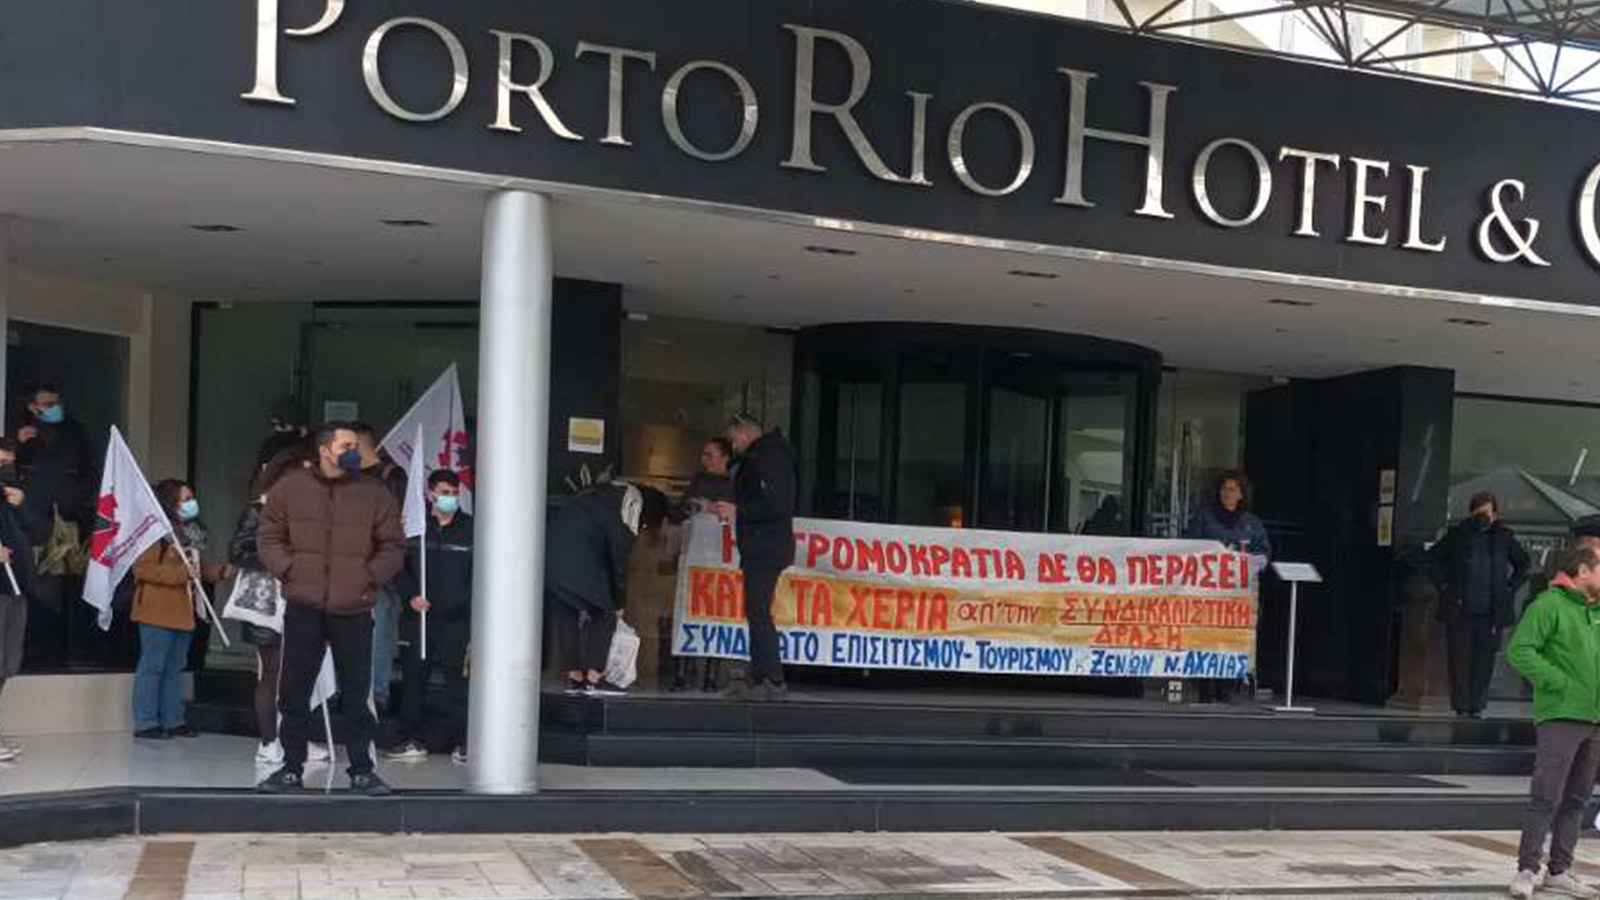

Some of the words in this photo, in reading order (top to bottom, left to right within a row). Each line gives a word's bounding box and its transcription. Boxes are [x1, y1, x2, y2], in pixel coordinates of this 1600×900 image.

[1477, 179, 1551, 267] &
[1037, 552, 1071, 583] ΔΕ
[1077, 554, 1117, 585] ΘΑ
[1126, 553, 1249, 590] ΠΕΡΑΣΕΙ
[788, 579, 833, 626] ΤΑ
[846, 585, 948, 632] ΧΕΡΙΑ
[680, 623, 819, 663] ΣΥΝΔΑΤΟ
[1093, 624, 1182, 650] ΔΡΑΣΗ
